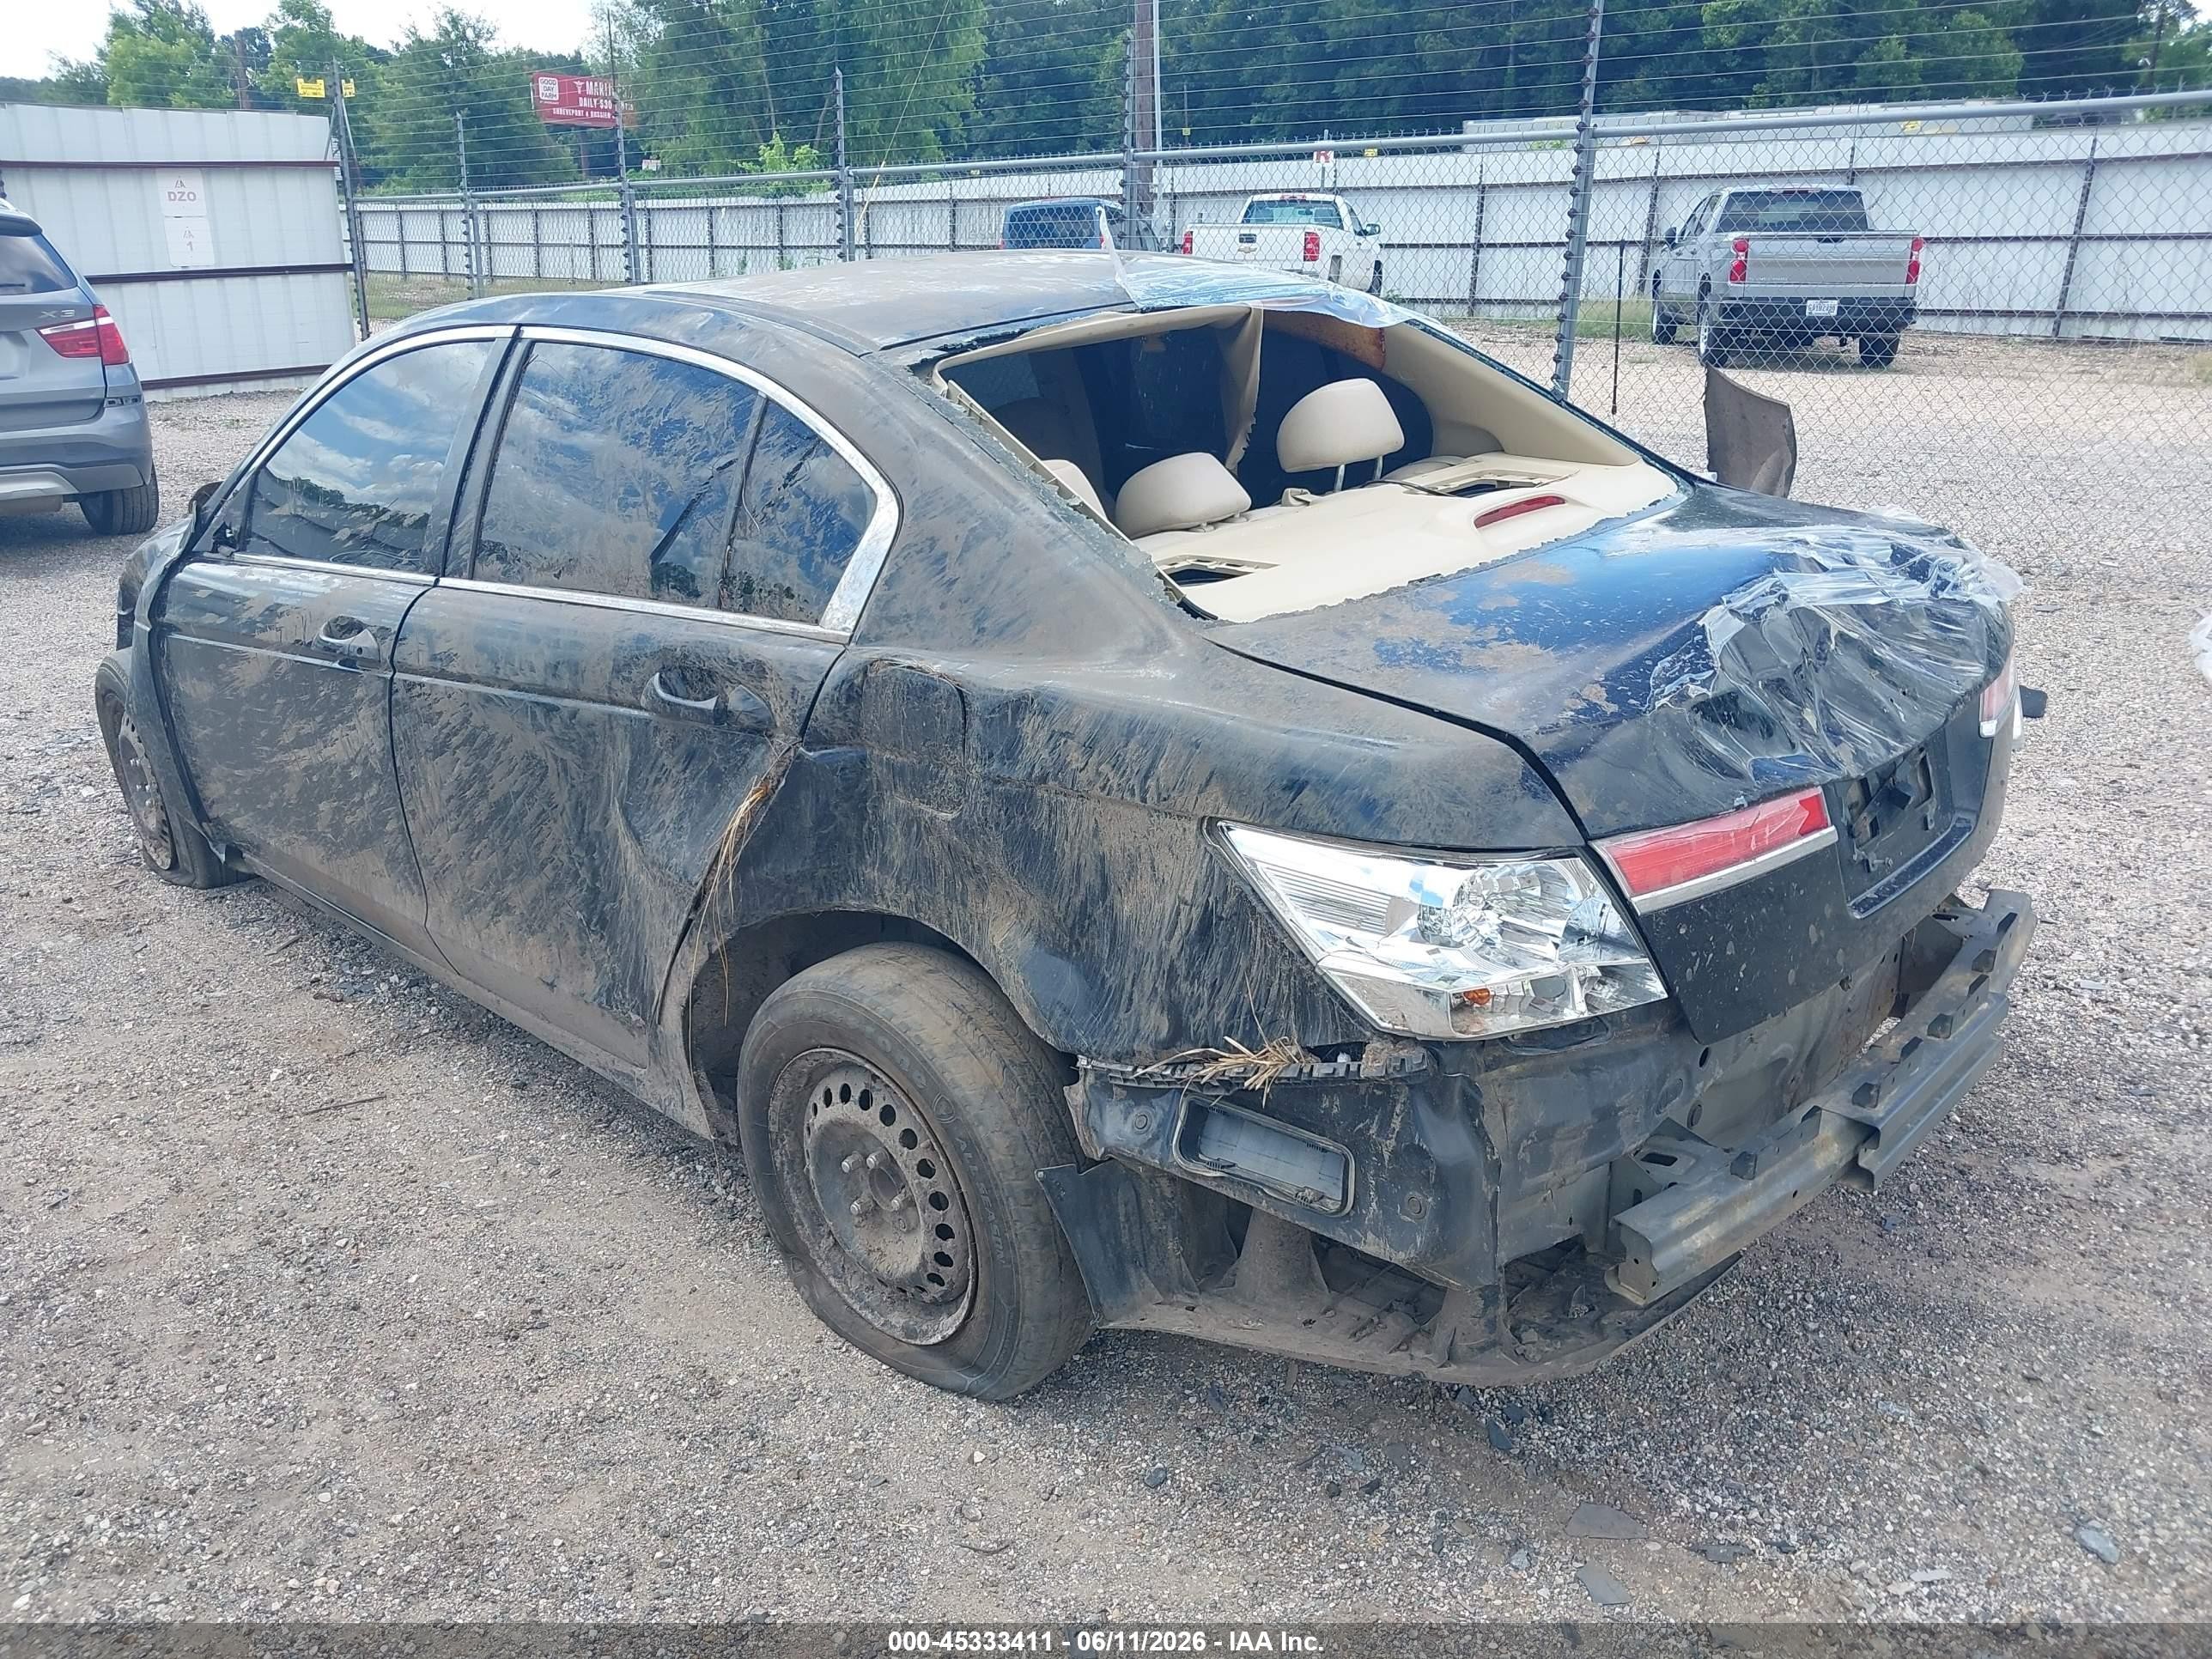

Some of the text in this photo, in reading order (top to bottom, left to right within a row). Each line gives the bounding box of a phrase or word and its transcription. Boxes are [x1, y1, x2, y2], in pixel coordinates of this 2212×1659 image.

[579, 97, 598, 109] DAILY
[552, 107, 584, 117] SHREVEPORT
[167, 191, 197, 202] DZO
[186, 241, 193, 252] 1
